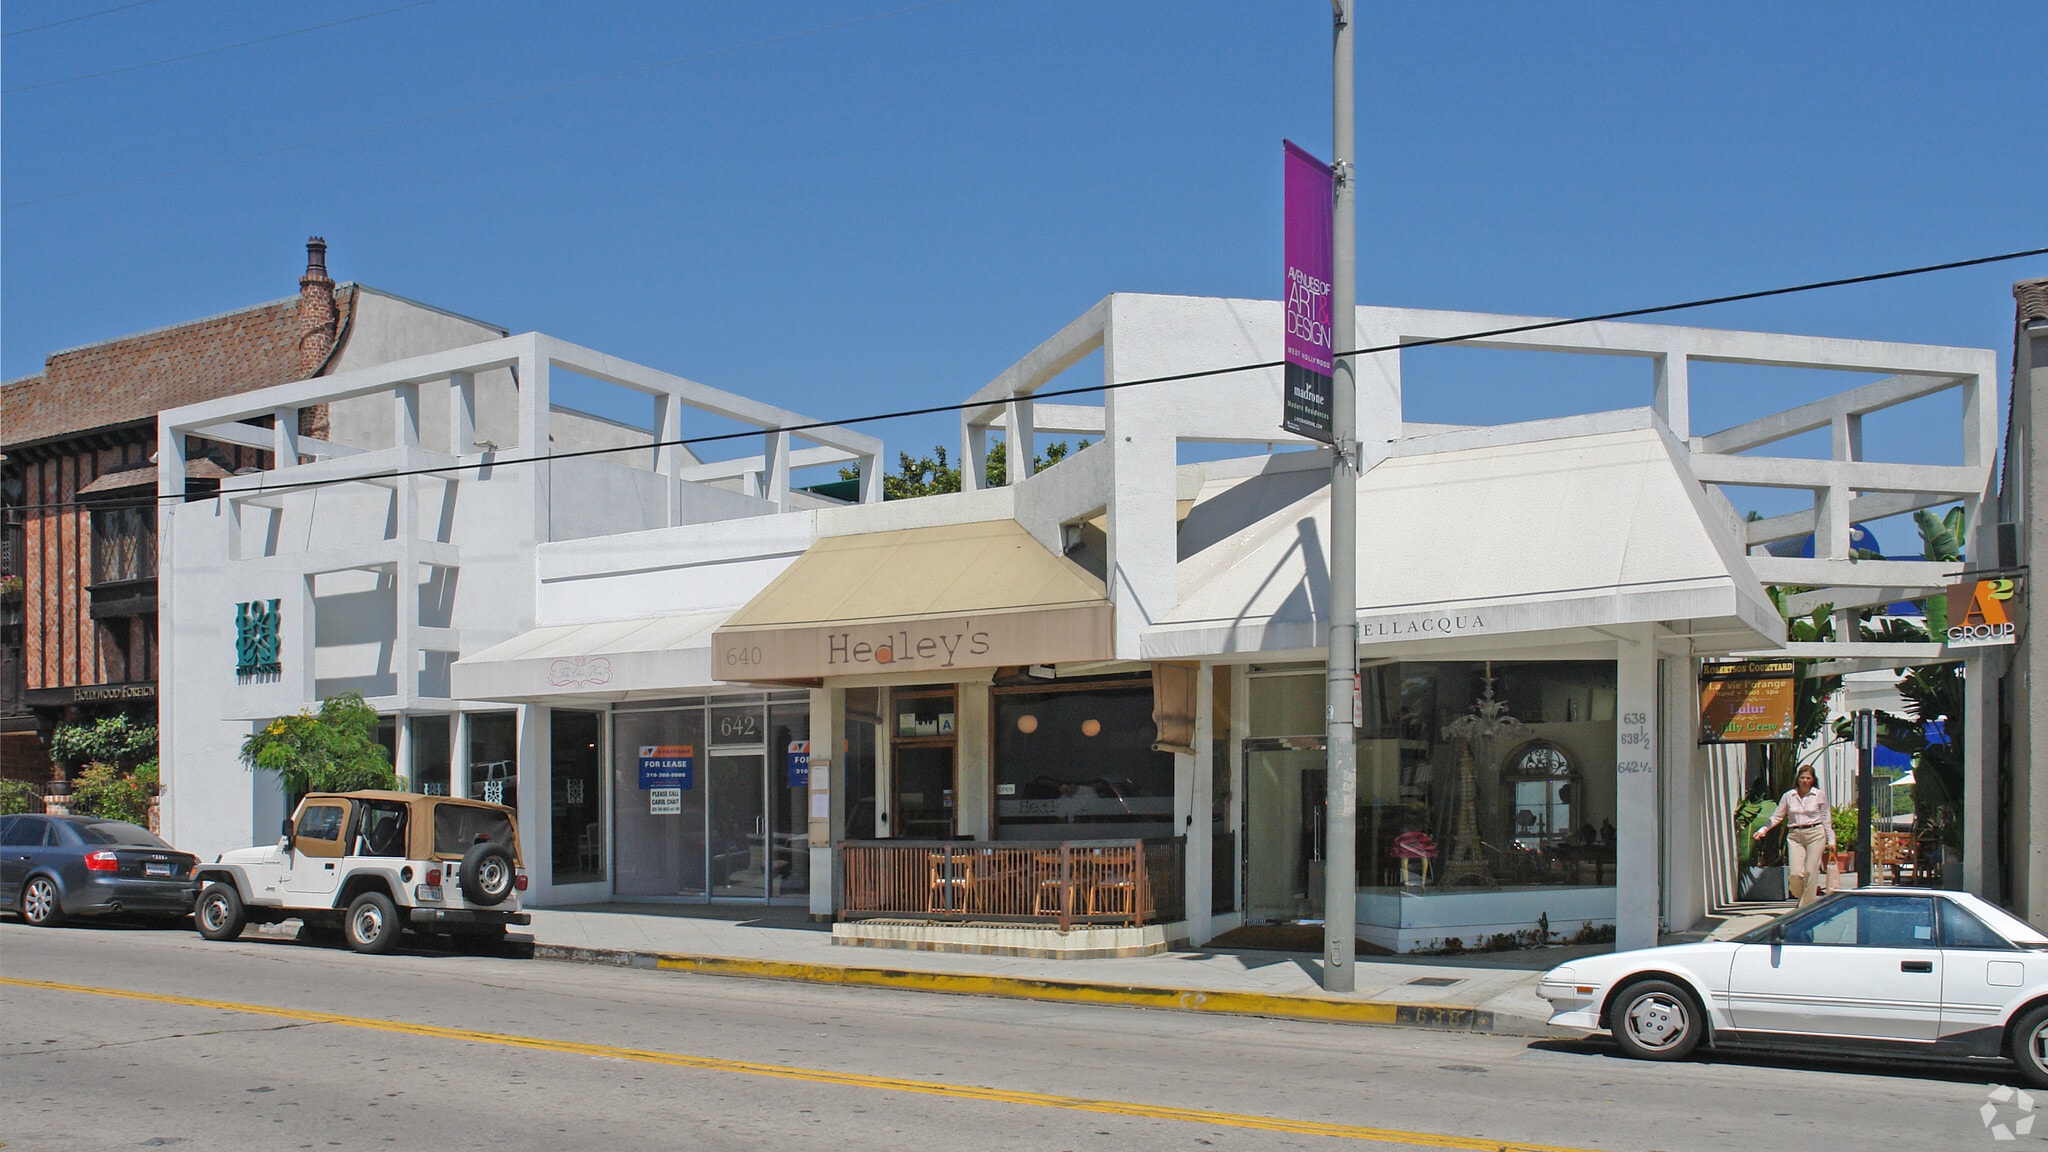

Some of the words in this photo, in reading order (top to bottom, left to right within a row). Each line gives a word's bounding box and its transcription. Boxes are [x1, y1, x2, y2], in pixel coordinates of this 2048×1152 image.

[1288, 266, 1320, 292] AVENUES
[1320, 281, 1330, 296] OF
[1288, 281, 1320, 320] ART
[1318, 295, 1331, 326] &
[1288, 309, 1331, 349] DESIGN
[1287, 346, 1301, 357] WEST
[1301, 353, 1331, 369] HOLLYWOOD
[1293, 382, 1325, 405] madrone
[1364, 614, 1484, 637] ELLACQUA
[1947, 622, 2015, 640] GROUP
[827, 620, 990, 668] Hedley's
[726, 646, 762, 666] 640
[1703, 664, 1748, 674] ROBERTSON
[1748, 661, 1793, 672] COURTYARD
[1727, 682, 1742, 690] vie
[1744, 679, 1787, 689] l'orange
[1766, 688, 1780, 696] spa
[74, 688, 120, 701] HOLLYWOOD
[1730, 703, 1766, 715] Lulur
[721, 715, 756, 737] 642
[943, 719, 952, 730] A
[1623, 712, 1647, 725] 638
[1746, 721, 1778, 731] Crew
[644, 760, 661, 768] FOR
[662, 760, 688, 768] LEASE
